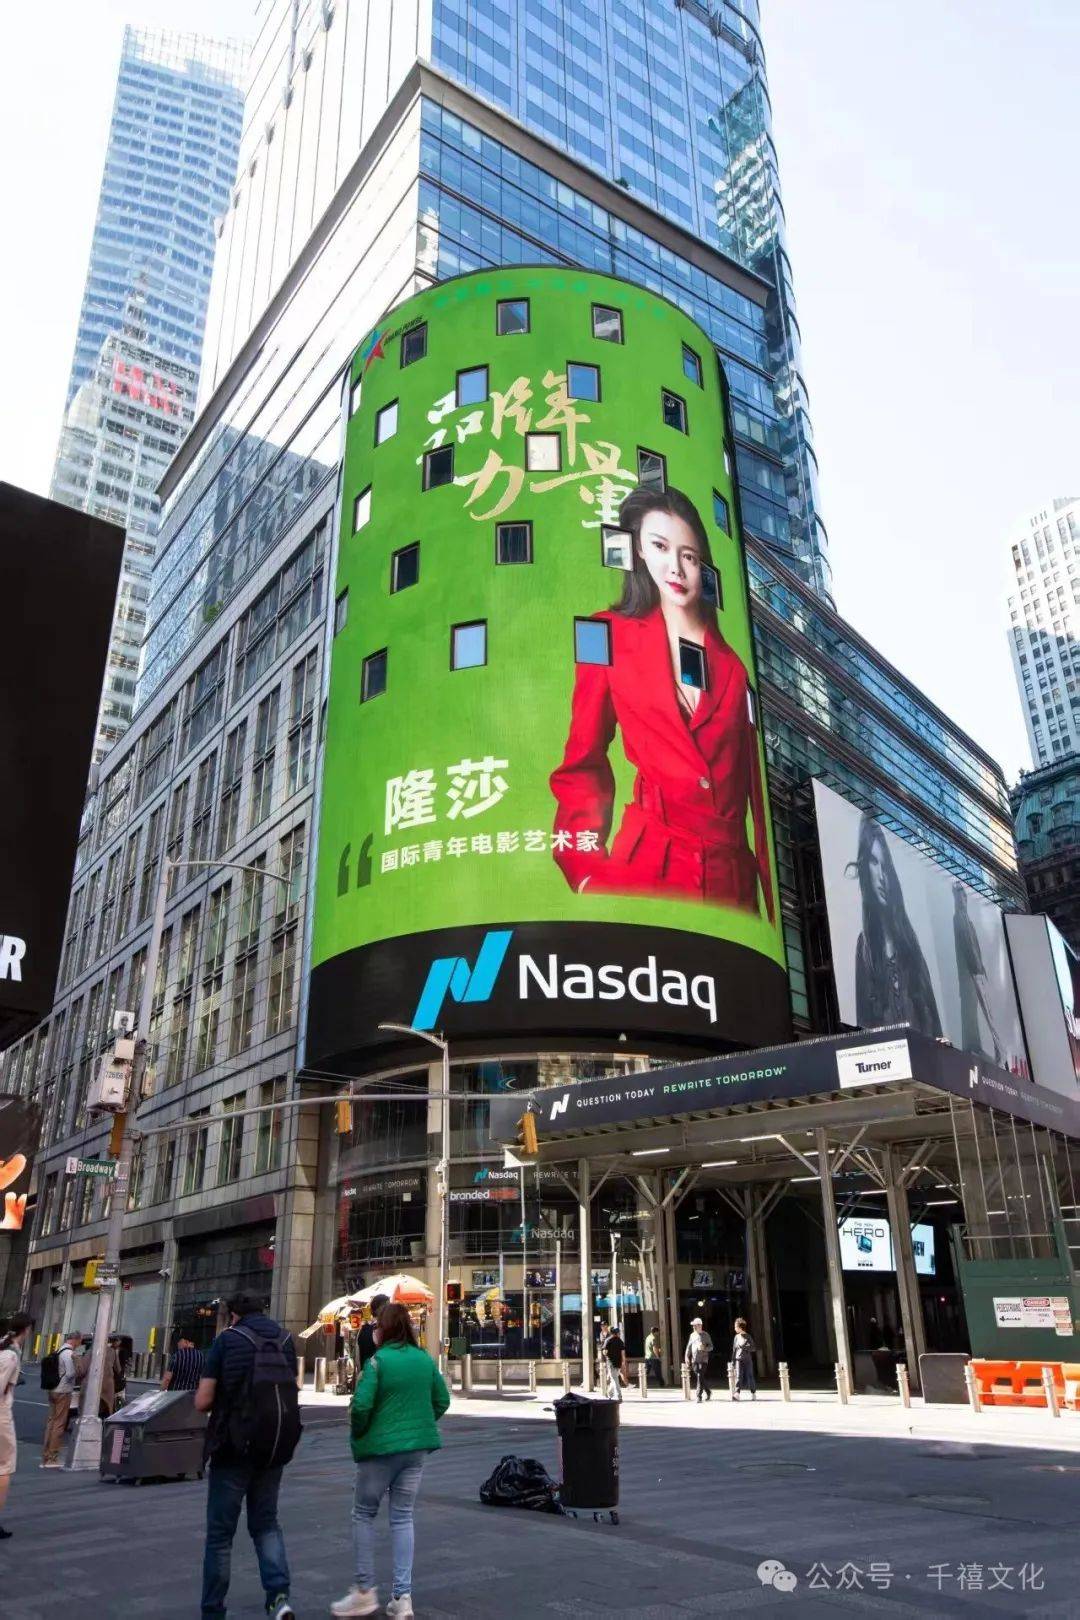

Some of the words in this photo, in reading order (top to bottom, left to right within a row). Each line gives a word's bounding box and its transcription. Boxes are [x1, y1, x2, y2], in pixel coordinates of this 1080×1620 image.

[384, 755, 510, 836] 隆莎
[380, 829, 600, 873] 国际青年电影艺术家
[0, 934, 27, 982] R
[518, 953, 718, 1024] Nasdaq
[855, 1060, 892, 1074] Turner
[576, 1093, 622, 1108] QUESTION
[625, 1087, 656, 1100] TODAY
[663, 1078, 712, 1094] REWRITE
[77, 1160, 114, 1177] Broadway
[488, 1171, 519, 1180] Nasdaq
[450, 1189, 490, 1201] branded
[531, 1228, 575, 1241] Nasdaq
[843, 1227, 885, 1238] HERO
